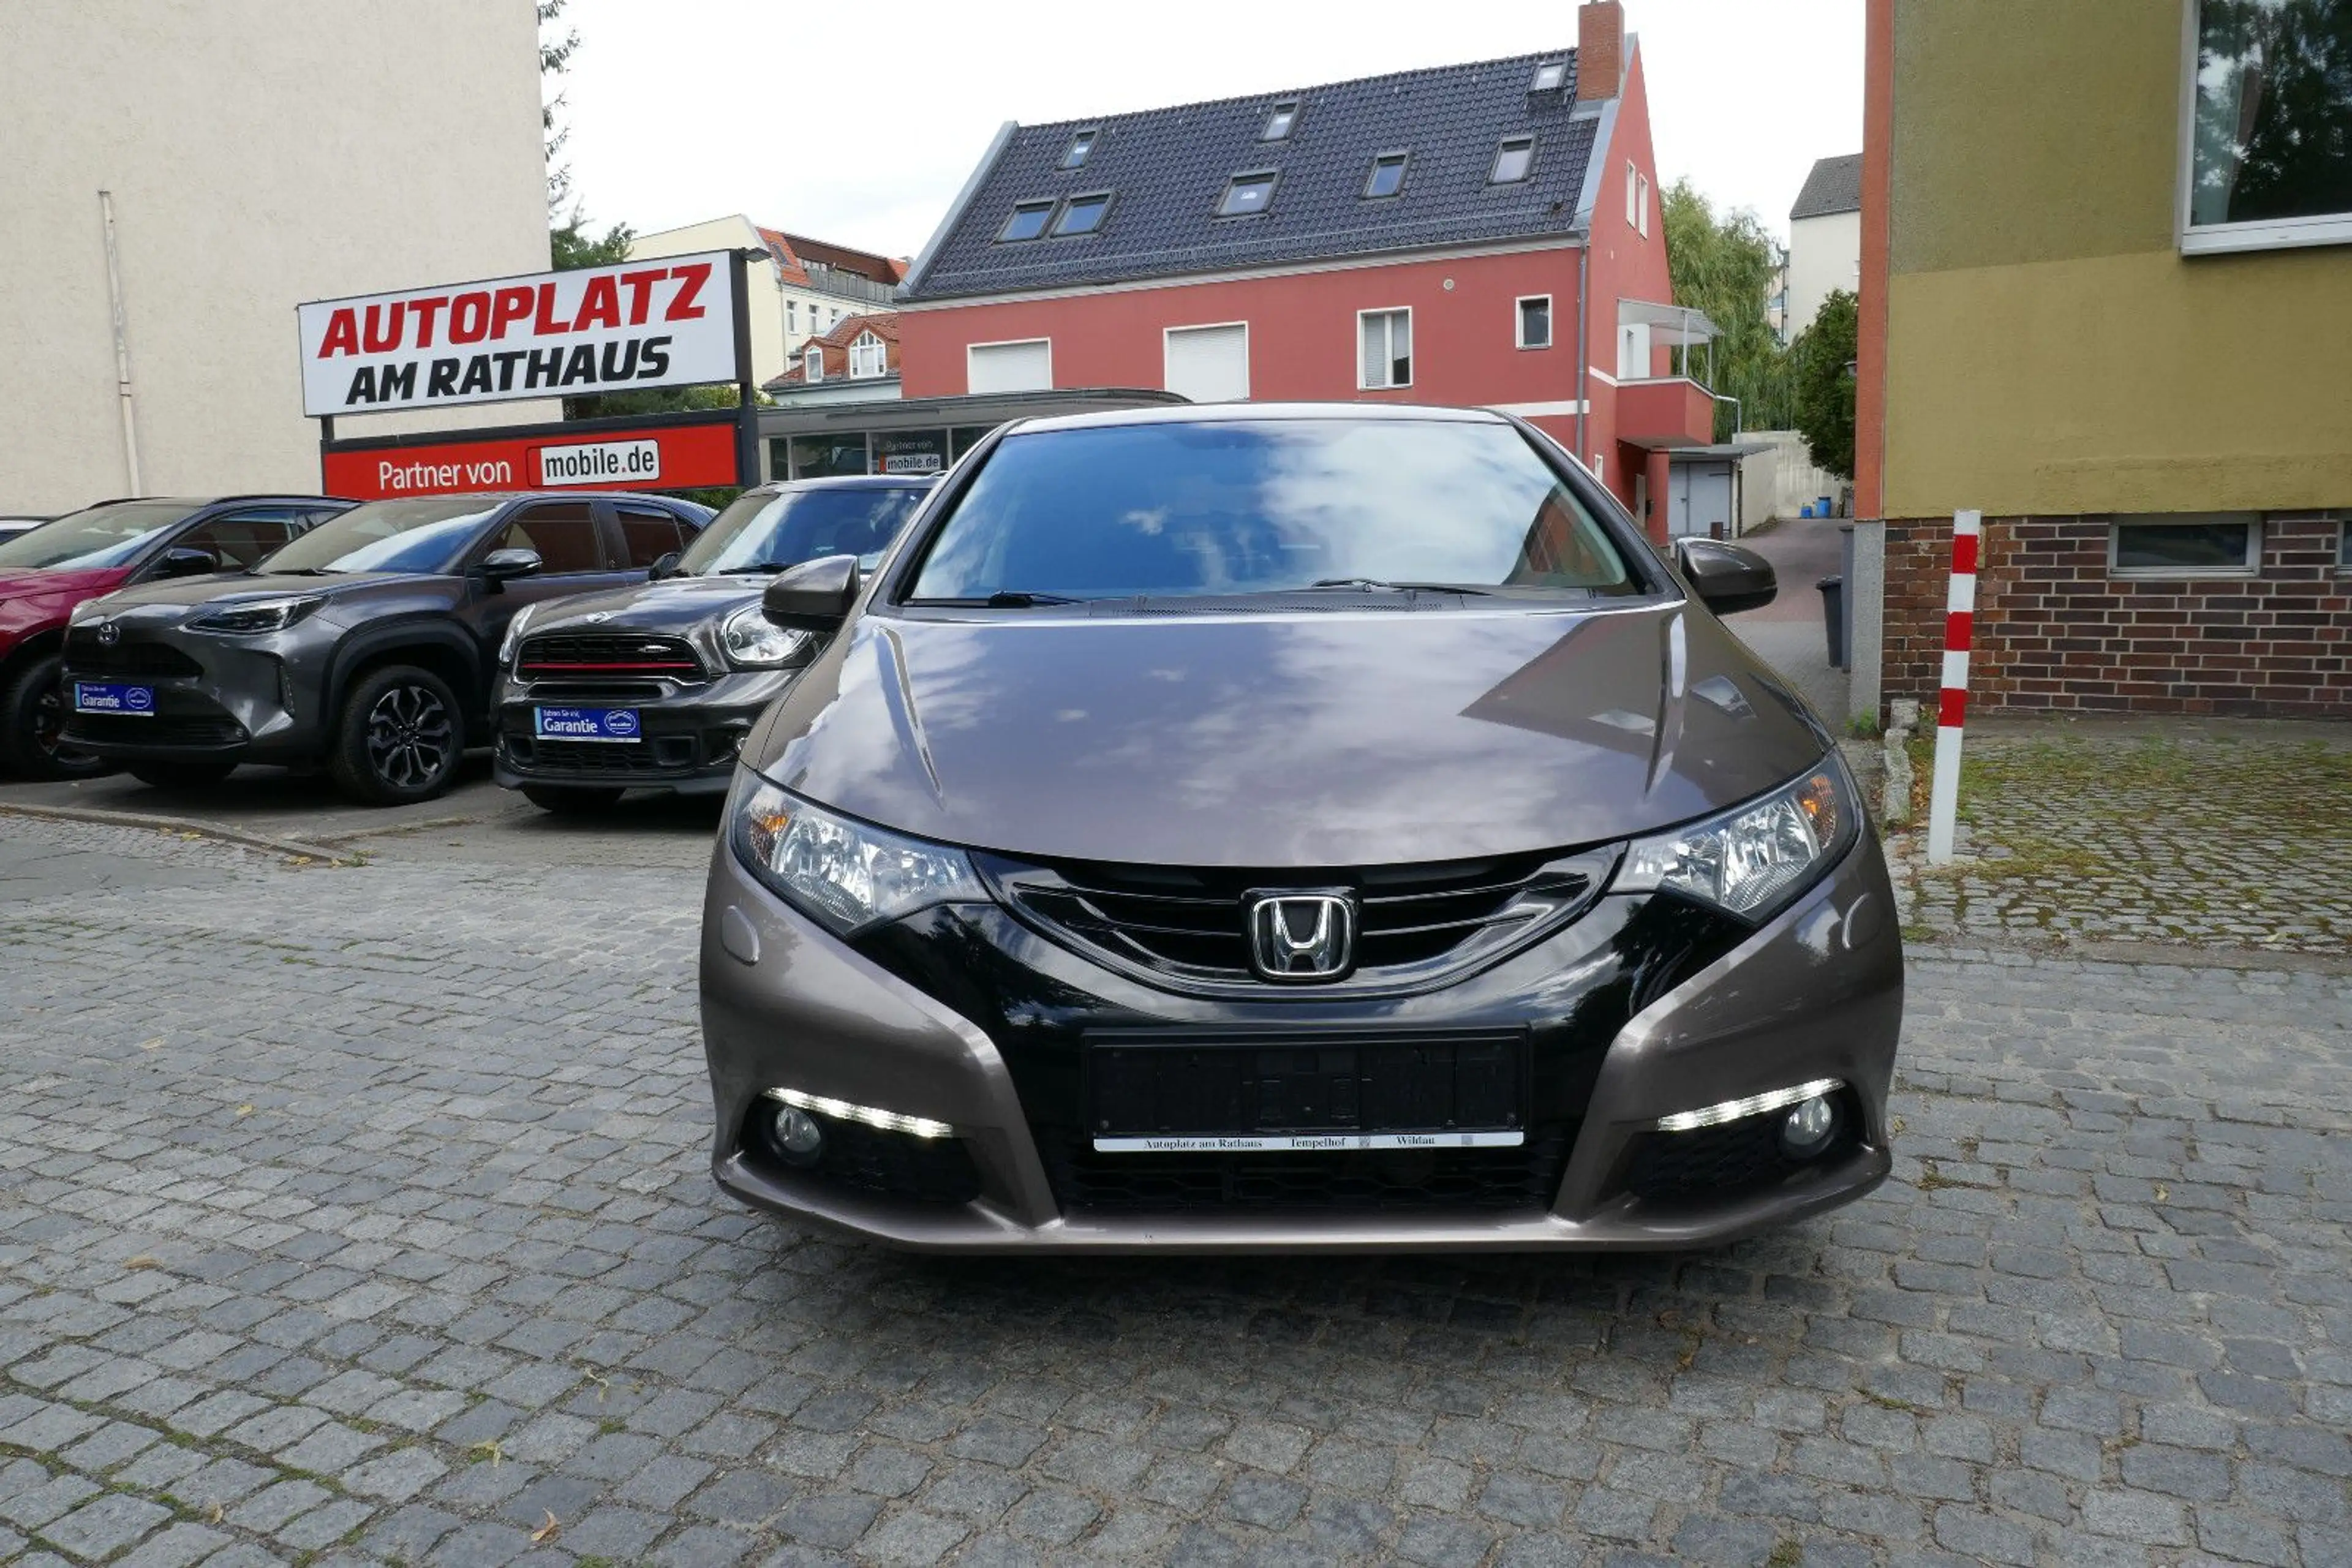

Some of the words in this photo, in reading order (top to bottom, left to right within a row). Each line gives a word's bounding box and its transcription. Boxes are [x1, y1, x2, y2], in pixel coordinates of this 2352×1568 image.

[317, 262, 713, 359] AUTOPLATZ
[345, 361, 418, 405] AM
[427, 335, 673, 398] RATHAUS
[379, 461, 461, 490] Partner
[466, 460, 511, 484] von
[545, 445, 655, 478] mobile.de
[887, 455, 939, 470] mobile.de
[81, 693, 120, 707] Garantie
[543, 717, 598, 733] Garantie
[1144, 1139, 1196, 1150] Autoplatz
[1218, 1139, 1262, 1148] Rathaus
[1291, 1137, 1346, 1148] Tempelhof
[1396, 1136, 1436, 1145] Wildau
